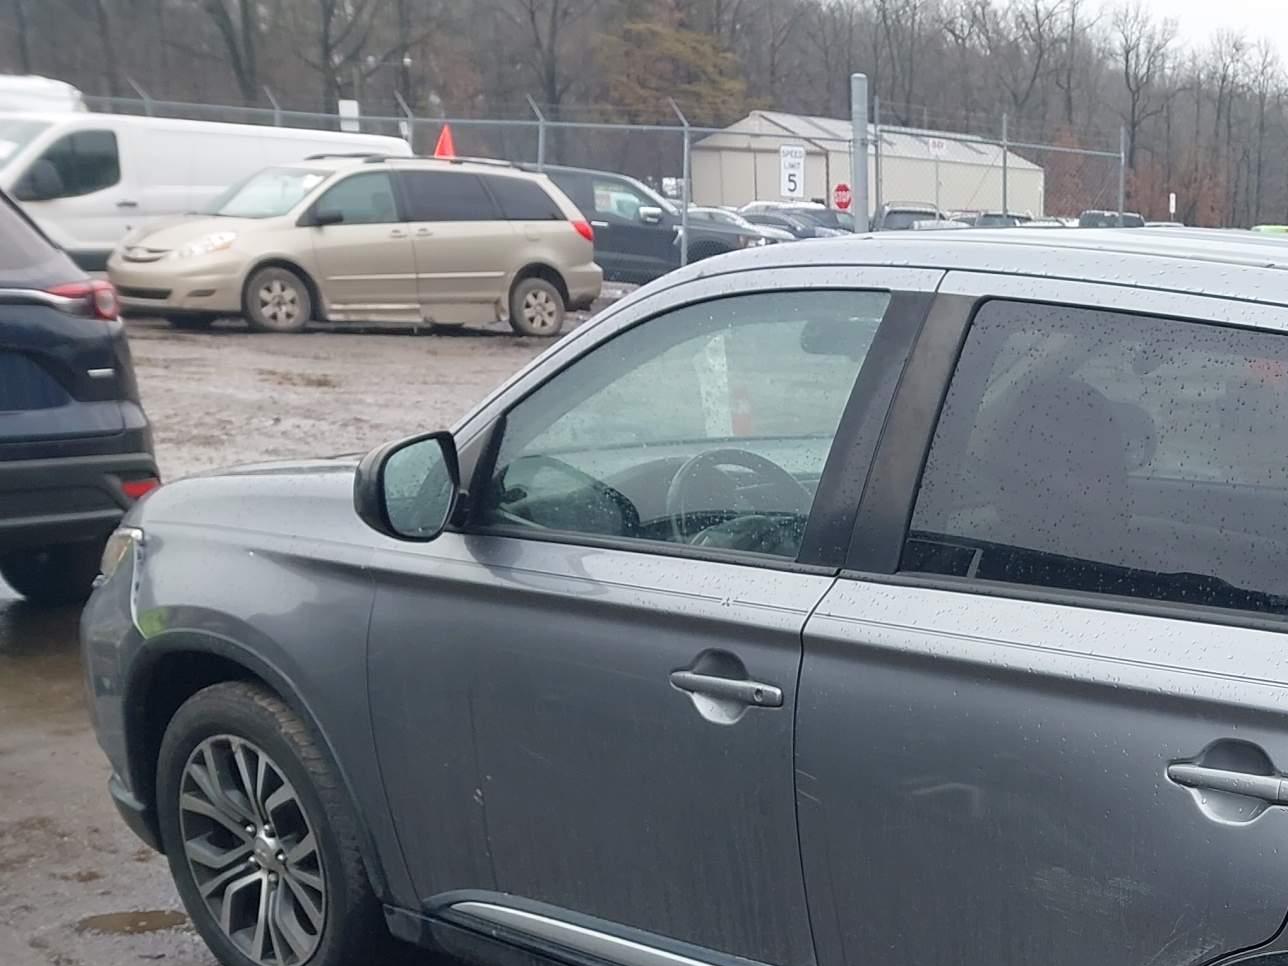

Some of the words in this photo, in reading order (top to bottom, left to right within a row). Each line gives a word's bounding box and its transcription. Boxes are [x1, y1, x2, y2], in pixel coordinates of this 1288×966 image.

[782, 149, 803, 159] SPEED
[783, 161, 801, 170] LIMIT
[787, 173, 798, 193] 5
